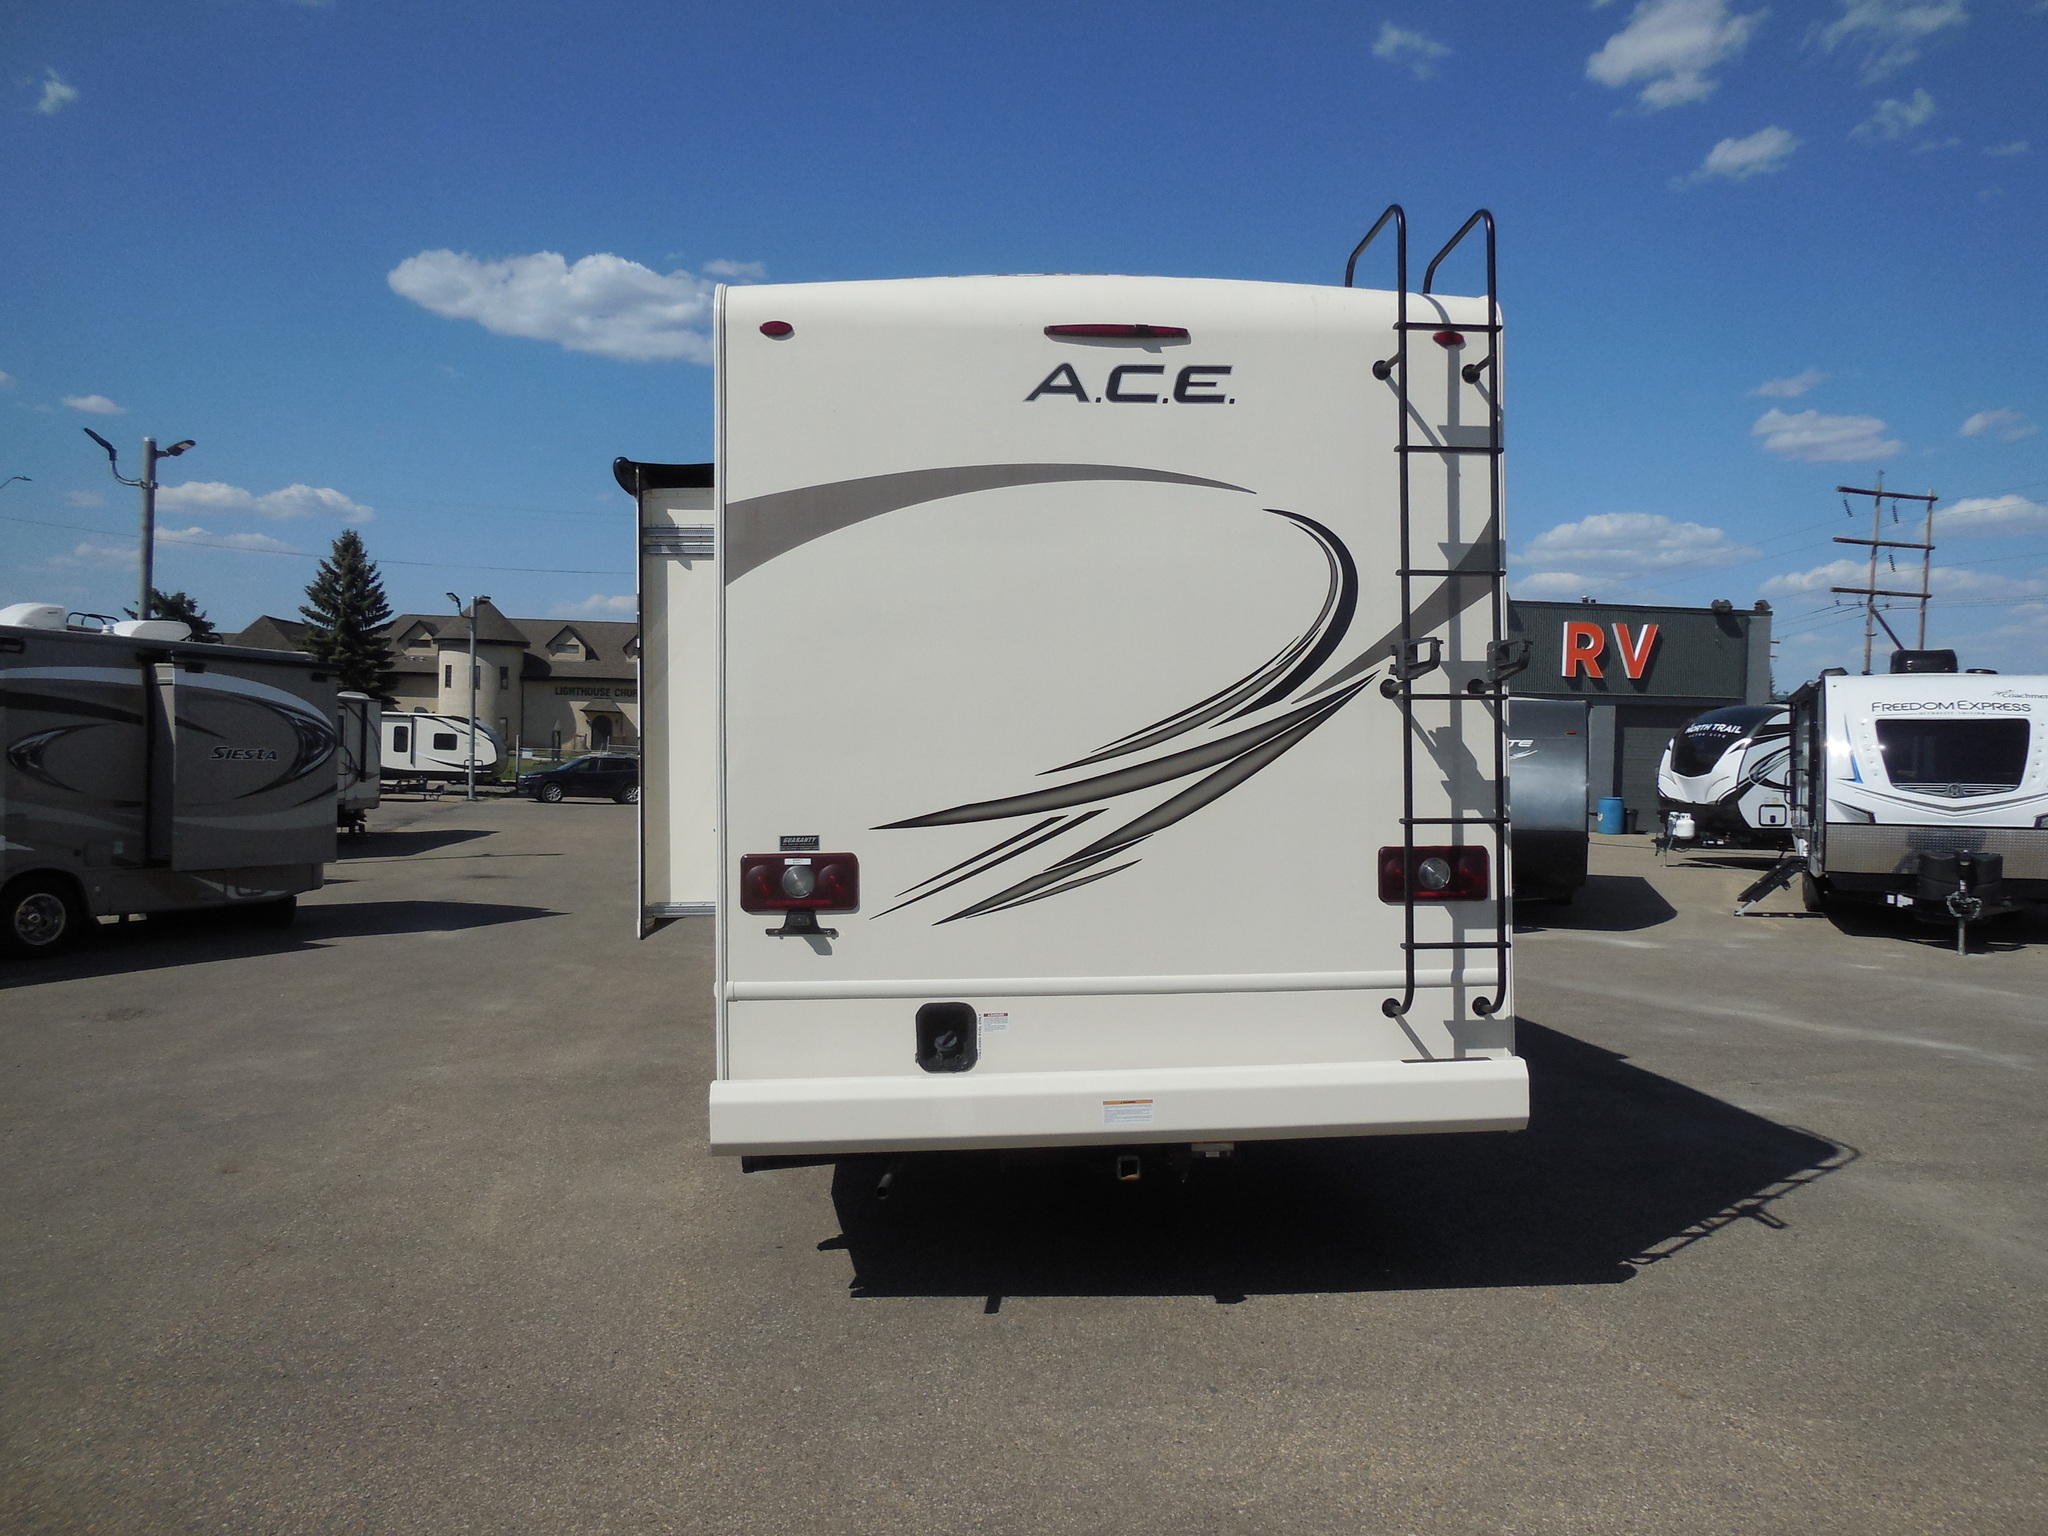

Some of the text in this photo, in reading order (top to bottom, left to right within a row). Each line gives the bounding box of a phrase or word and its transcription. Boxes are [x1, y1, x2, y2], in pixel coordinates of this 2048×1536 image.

[1022, 362, 1235, 405] A.C.E.
[1562, 621, 1659, 679] RV
[555, 686, 611, 697] LIGHTHOUSE
[1871, 700, 2031, 712] FREEDOM EXPRESS
[1684, 723, 1742, 734] NORTH TRAIL
